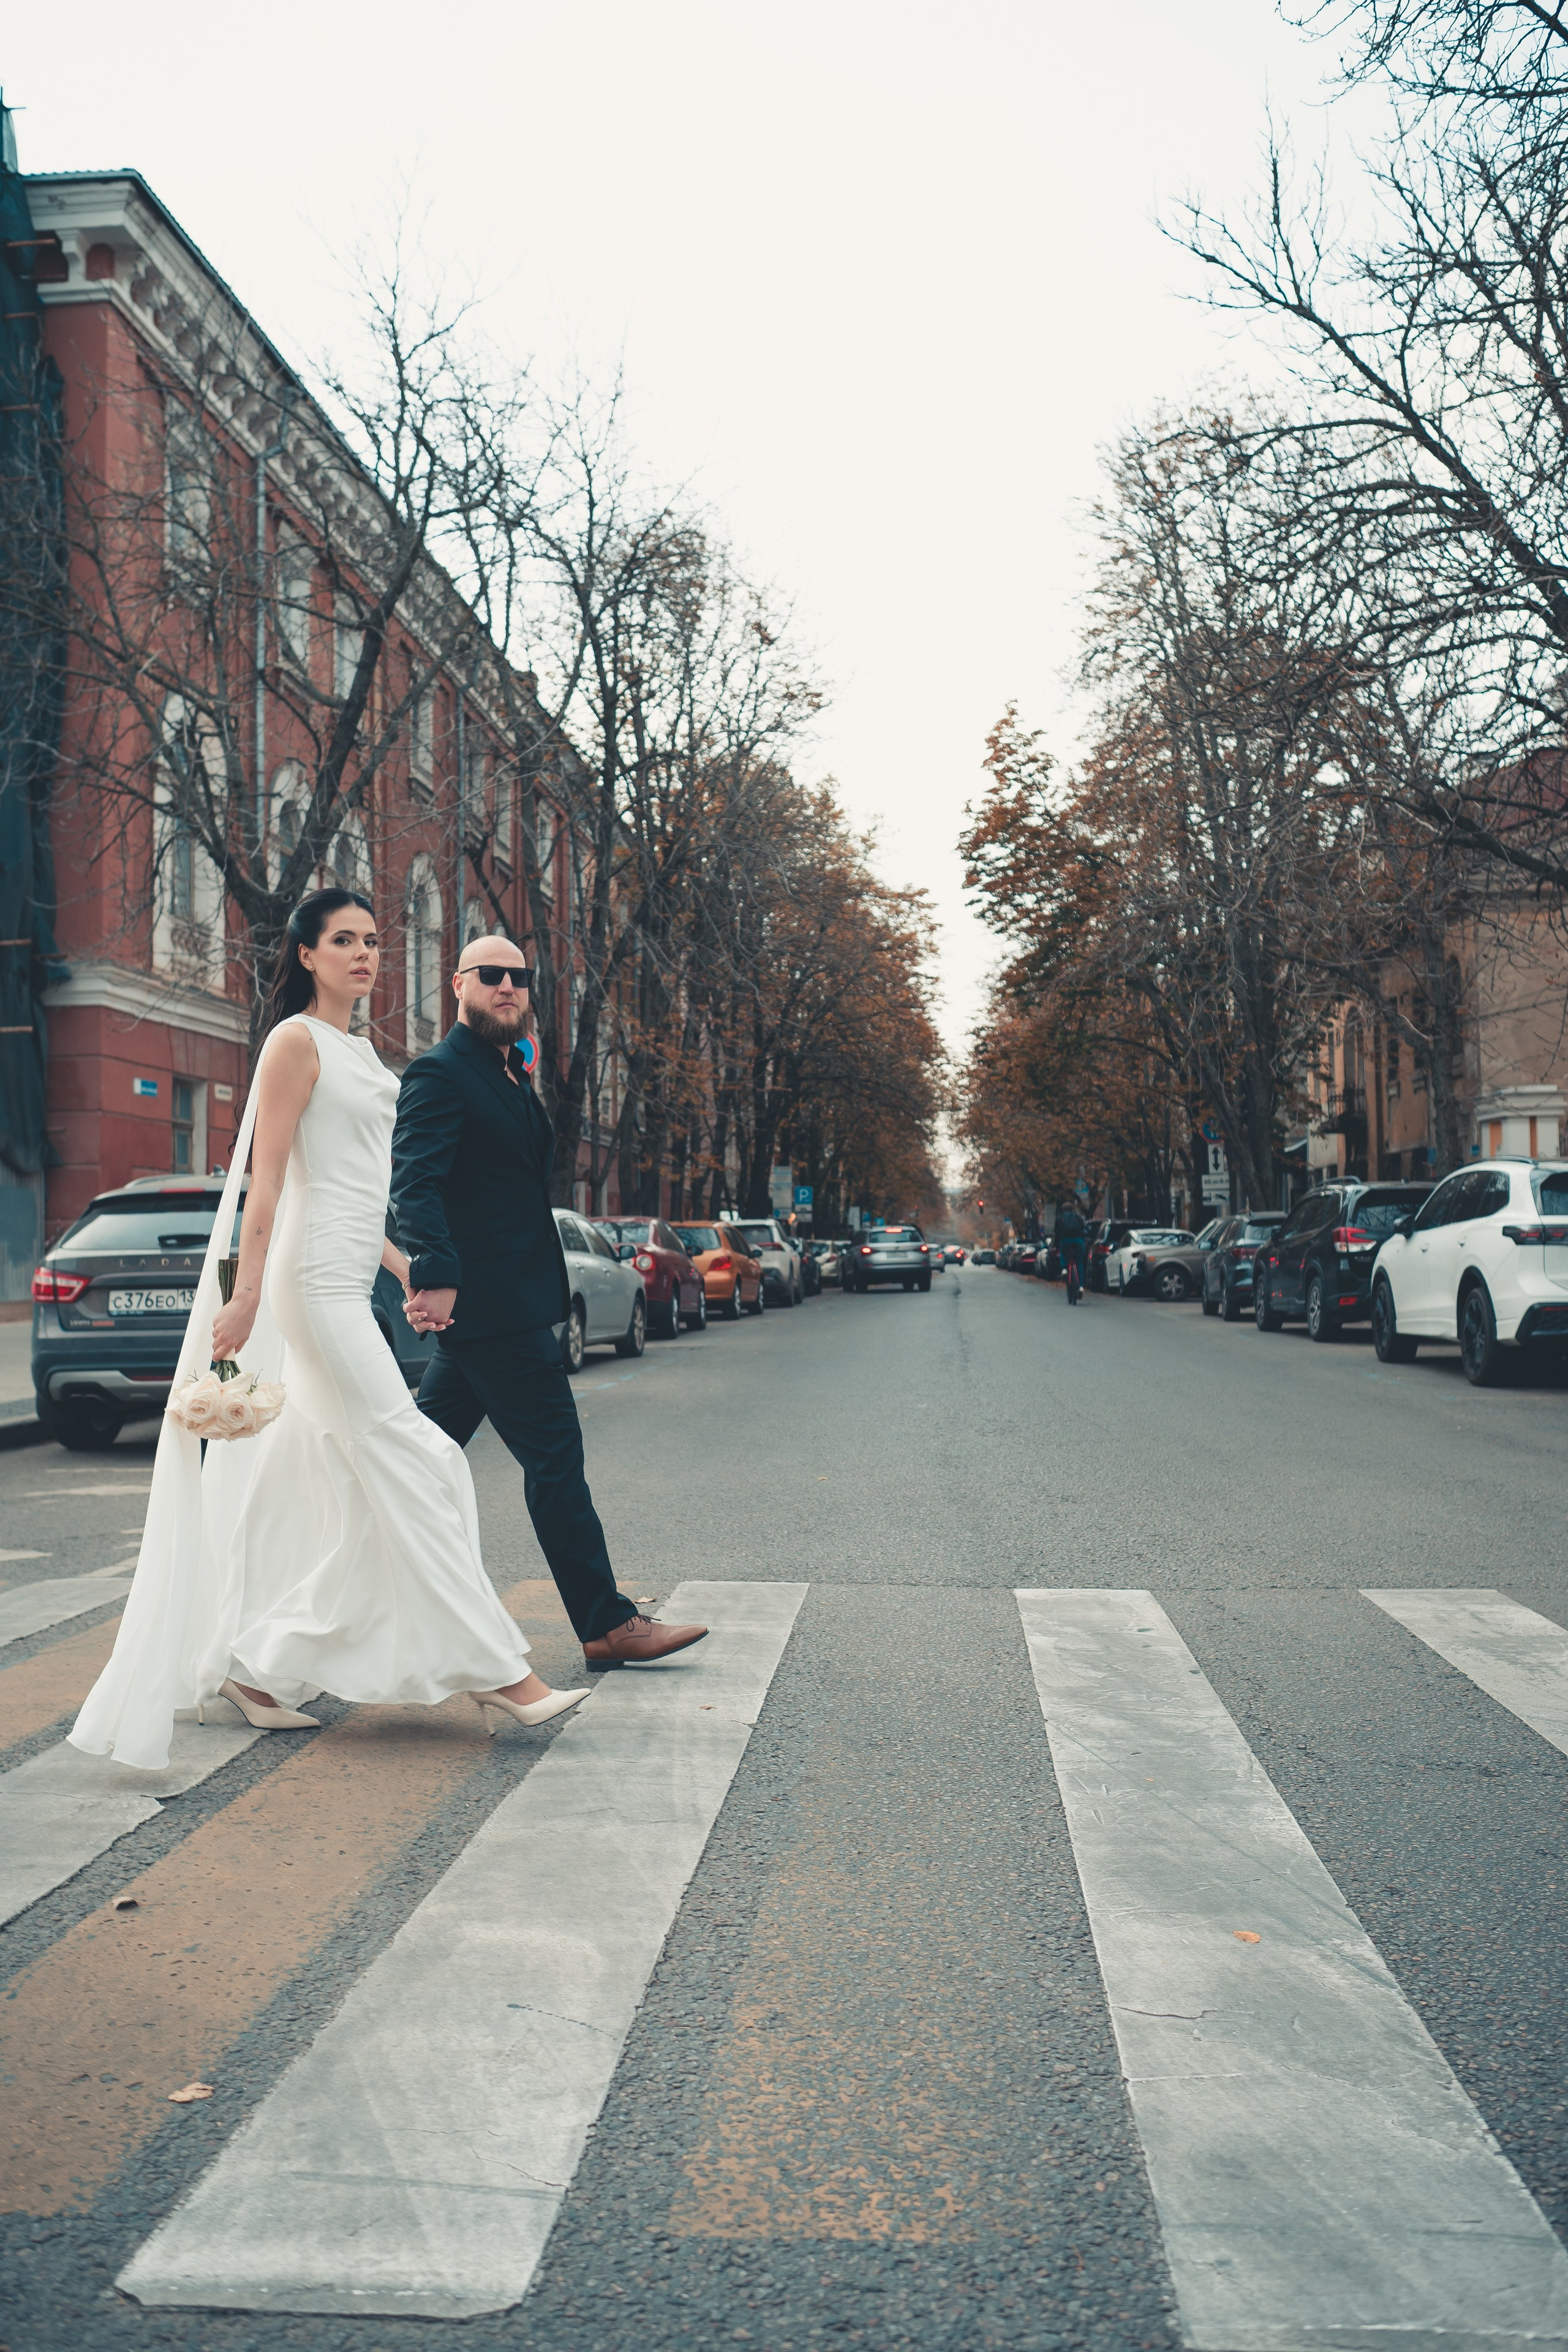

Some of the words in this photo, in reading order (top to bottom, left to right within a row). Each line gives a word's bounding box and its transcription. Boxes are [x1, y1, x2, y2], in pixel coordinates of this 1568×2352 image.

[799, 1189, 809, 1201] P
[119, 1257, 192, 1268] LADA
[179, 1290, 194, 1303] 13
